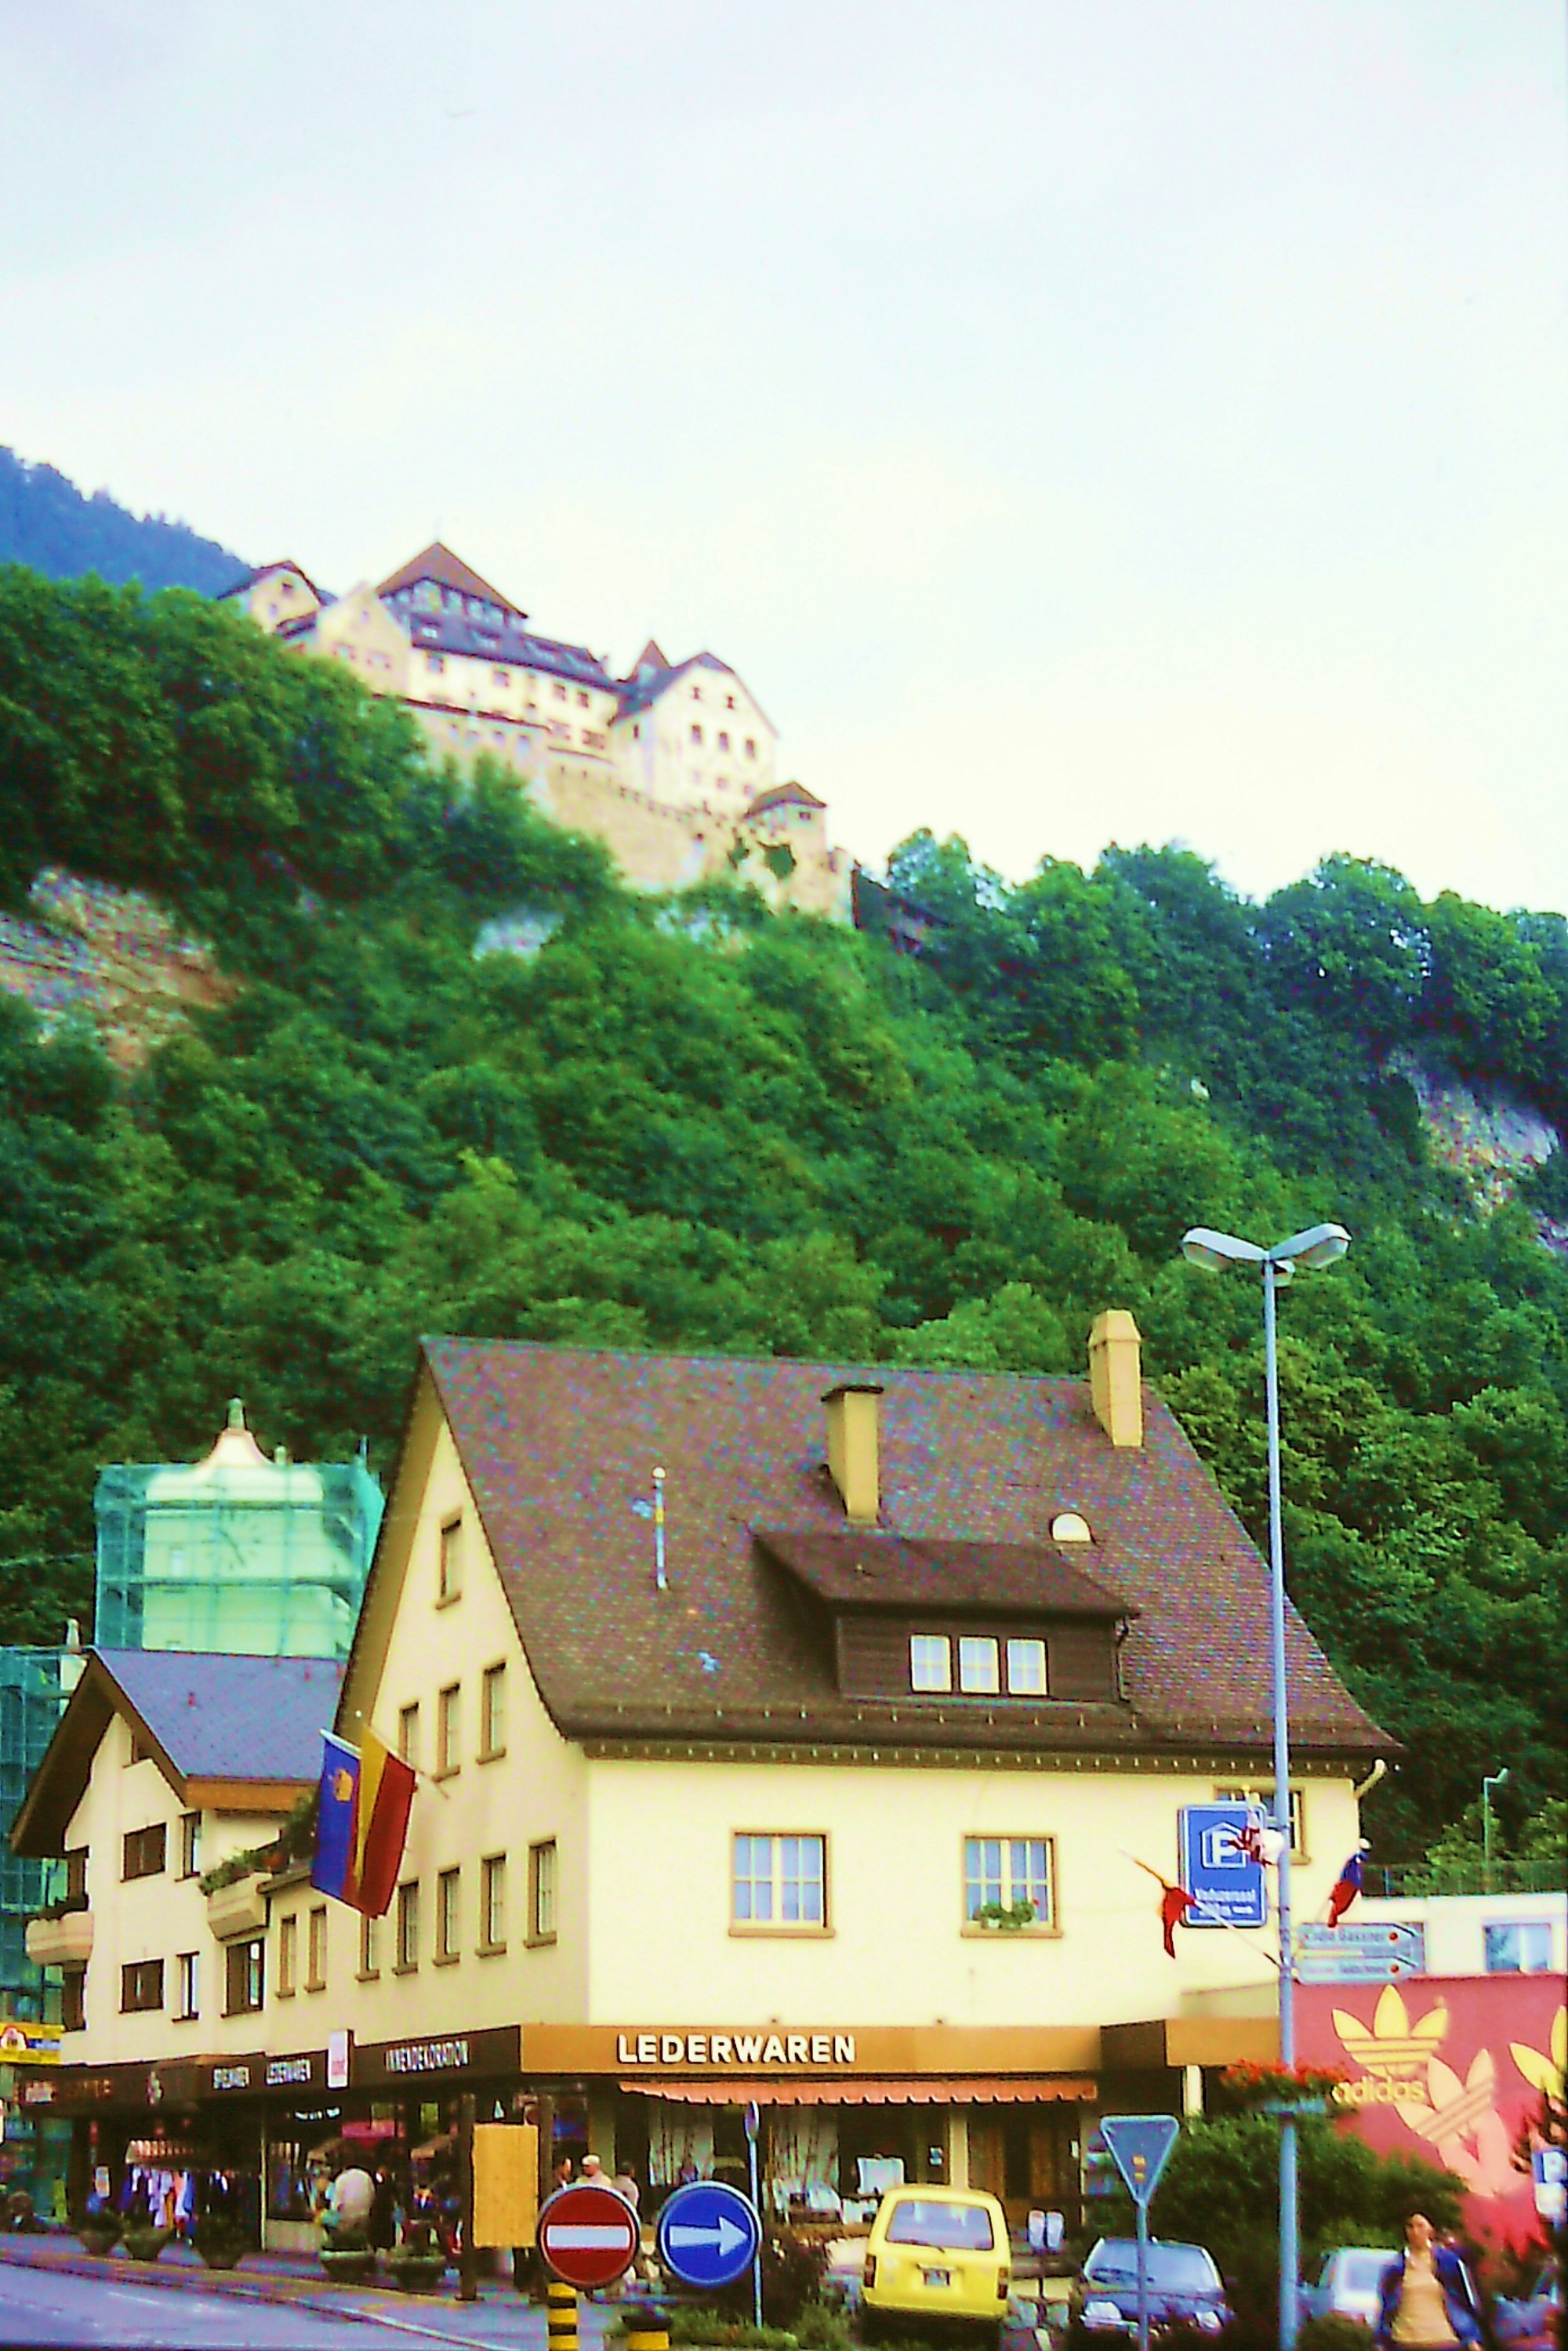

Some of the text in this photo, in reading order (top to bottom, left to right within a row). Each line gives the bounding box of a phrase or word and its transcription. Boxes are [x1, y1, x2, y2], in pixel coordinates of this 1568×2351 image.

[1212, 1830, 1239, 1864] P
[617, 2034, 855, 2063] LEDERWAREN
[1331, 2076, 1425, 2103] adidas
